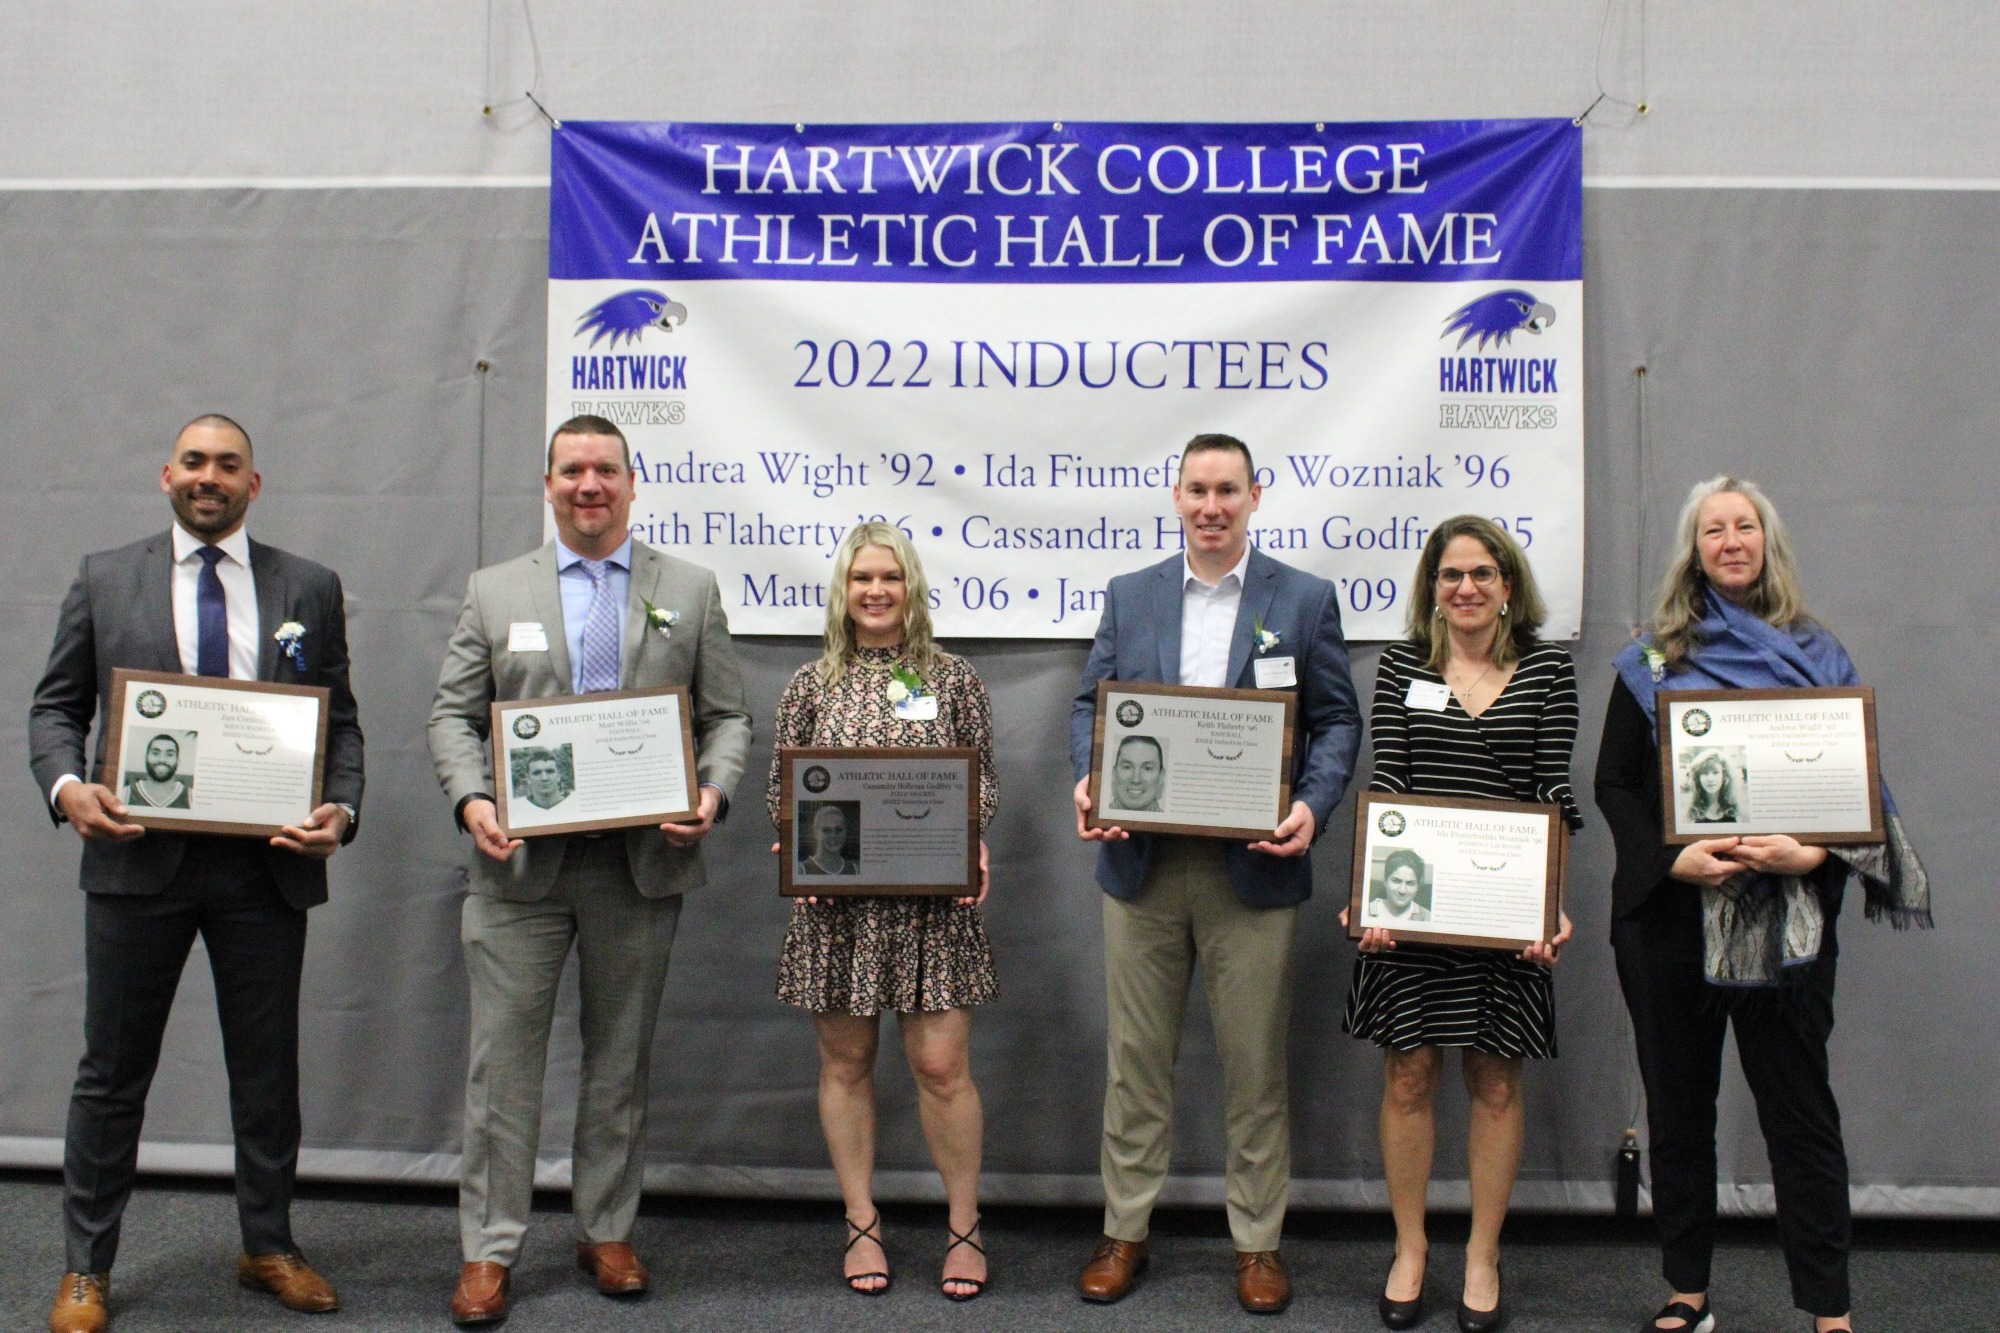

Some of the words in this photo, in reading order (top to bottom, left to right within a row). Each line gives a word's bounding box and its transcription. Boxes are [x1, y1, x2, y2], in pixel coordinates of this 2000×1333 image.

[700, 143, 1080, 195] HARTWICK
[1098, 143, 1428, 194] COLLEGE
[627, 211, 977, 267] ATHLETIC
[994, 214, 1184, 267] HALL
[1203, 214, 1297, 267] OF
[1312, 212, 1502, 266] FAME
[572, 355, 687, 390] HARTWICK
[793, 340, 932, 388] 2022
[950, 340, 1329, 390] INDUCTEES
[1440, 357, 1558, 394] HARTWICK
[1440, 404, 1558, 429] HAWKS
[631, 450, 746, 483] Andrea
[757, 451, 869, 498] Wight
[880, 453, 937, 487] ’92
[983, 453, 1037, 488] Ida
[1048, 453, 1276, 488] Fiumefo
[1288, 454, 1443, 488] Wozniak
[1454, 454, 1511, 488] ’96
[629, 513, 690, 545] eith
[702, 511, 846, 559] Flaherty
[961, 515, 1141, 550] Cassandra
[1321, 516, 1429, 550] Godfr
[740, 573, 826, 608] Matt
[953, 576, 1009, 610] ’06
[1341, 577, 1397, 612] ’09
[175, 699, 229, 712] ATHLETIC
[230, 703, 255, 714] HAL
[548, 713, 596, 725] ATHLETIC
[598, 711, 625, 721] HALL
[626, 709, 640, 718] OF
[641, 707, 669, 717] FAME
[598, 721, 615, 729] Matt
[1151, 708, 1200, 719] ATHLETIC
[1202, 710, 1229, 721] HALL
[1230, 712, 1244, 722] OF
[1246, 713, 1274, 724] FAME
[1719, 713, 1772, 723] ATHLETIC
[1775, 713, 1803, 722] HALL
[1804, 712, 1820, 721] OF
[1822, 711, 1852, 721] FAME
[1197, 721, 1215, 729] Keith
[1217, 722, 1245, 732] Flaherty
[1769, 724, 1797, 732] Andrea
[1798, 723, 1822, 732] Wight
[839, 772, 886, 781] ATHLETIC
[888, 772, 914, 781] HALL
[915, 772, 929, 781] OF
[931, 772, 958, 781] FAME
[1413, 818, 1463, 830] ATHLETIC
[1465, 821, 1491, 832] HALL
[1493, 823, 1507, 833] OF
[1509, 824, 1538, 835] FAME
[1436, 830, 1449, 838] Ida
